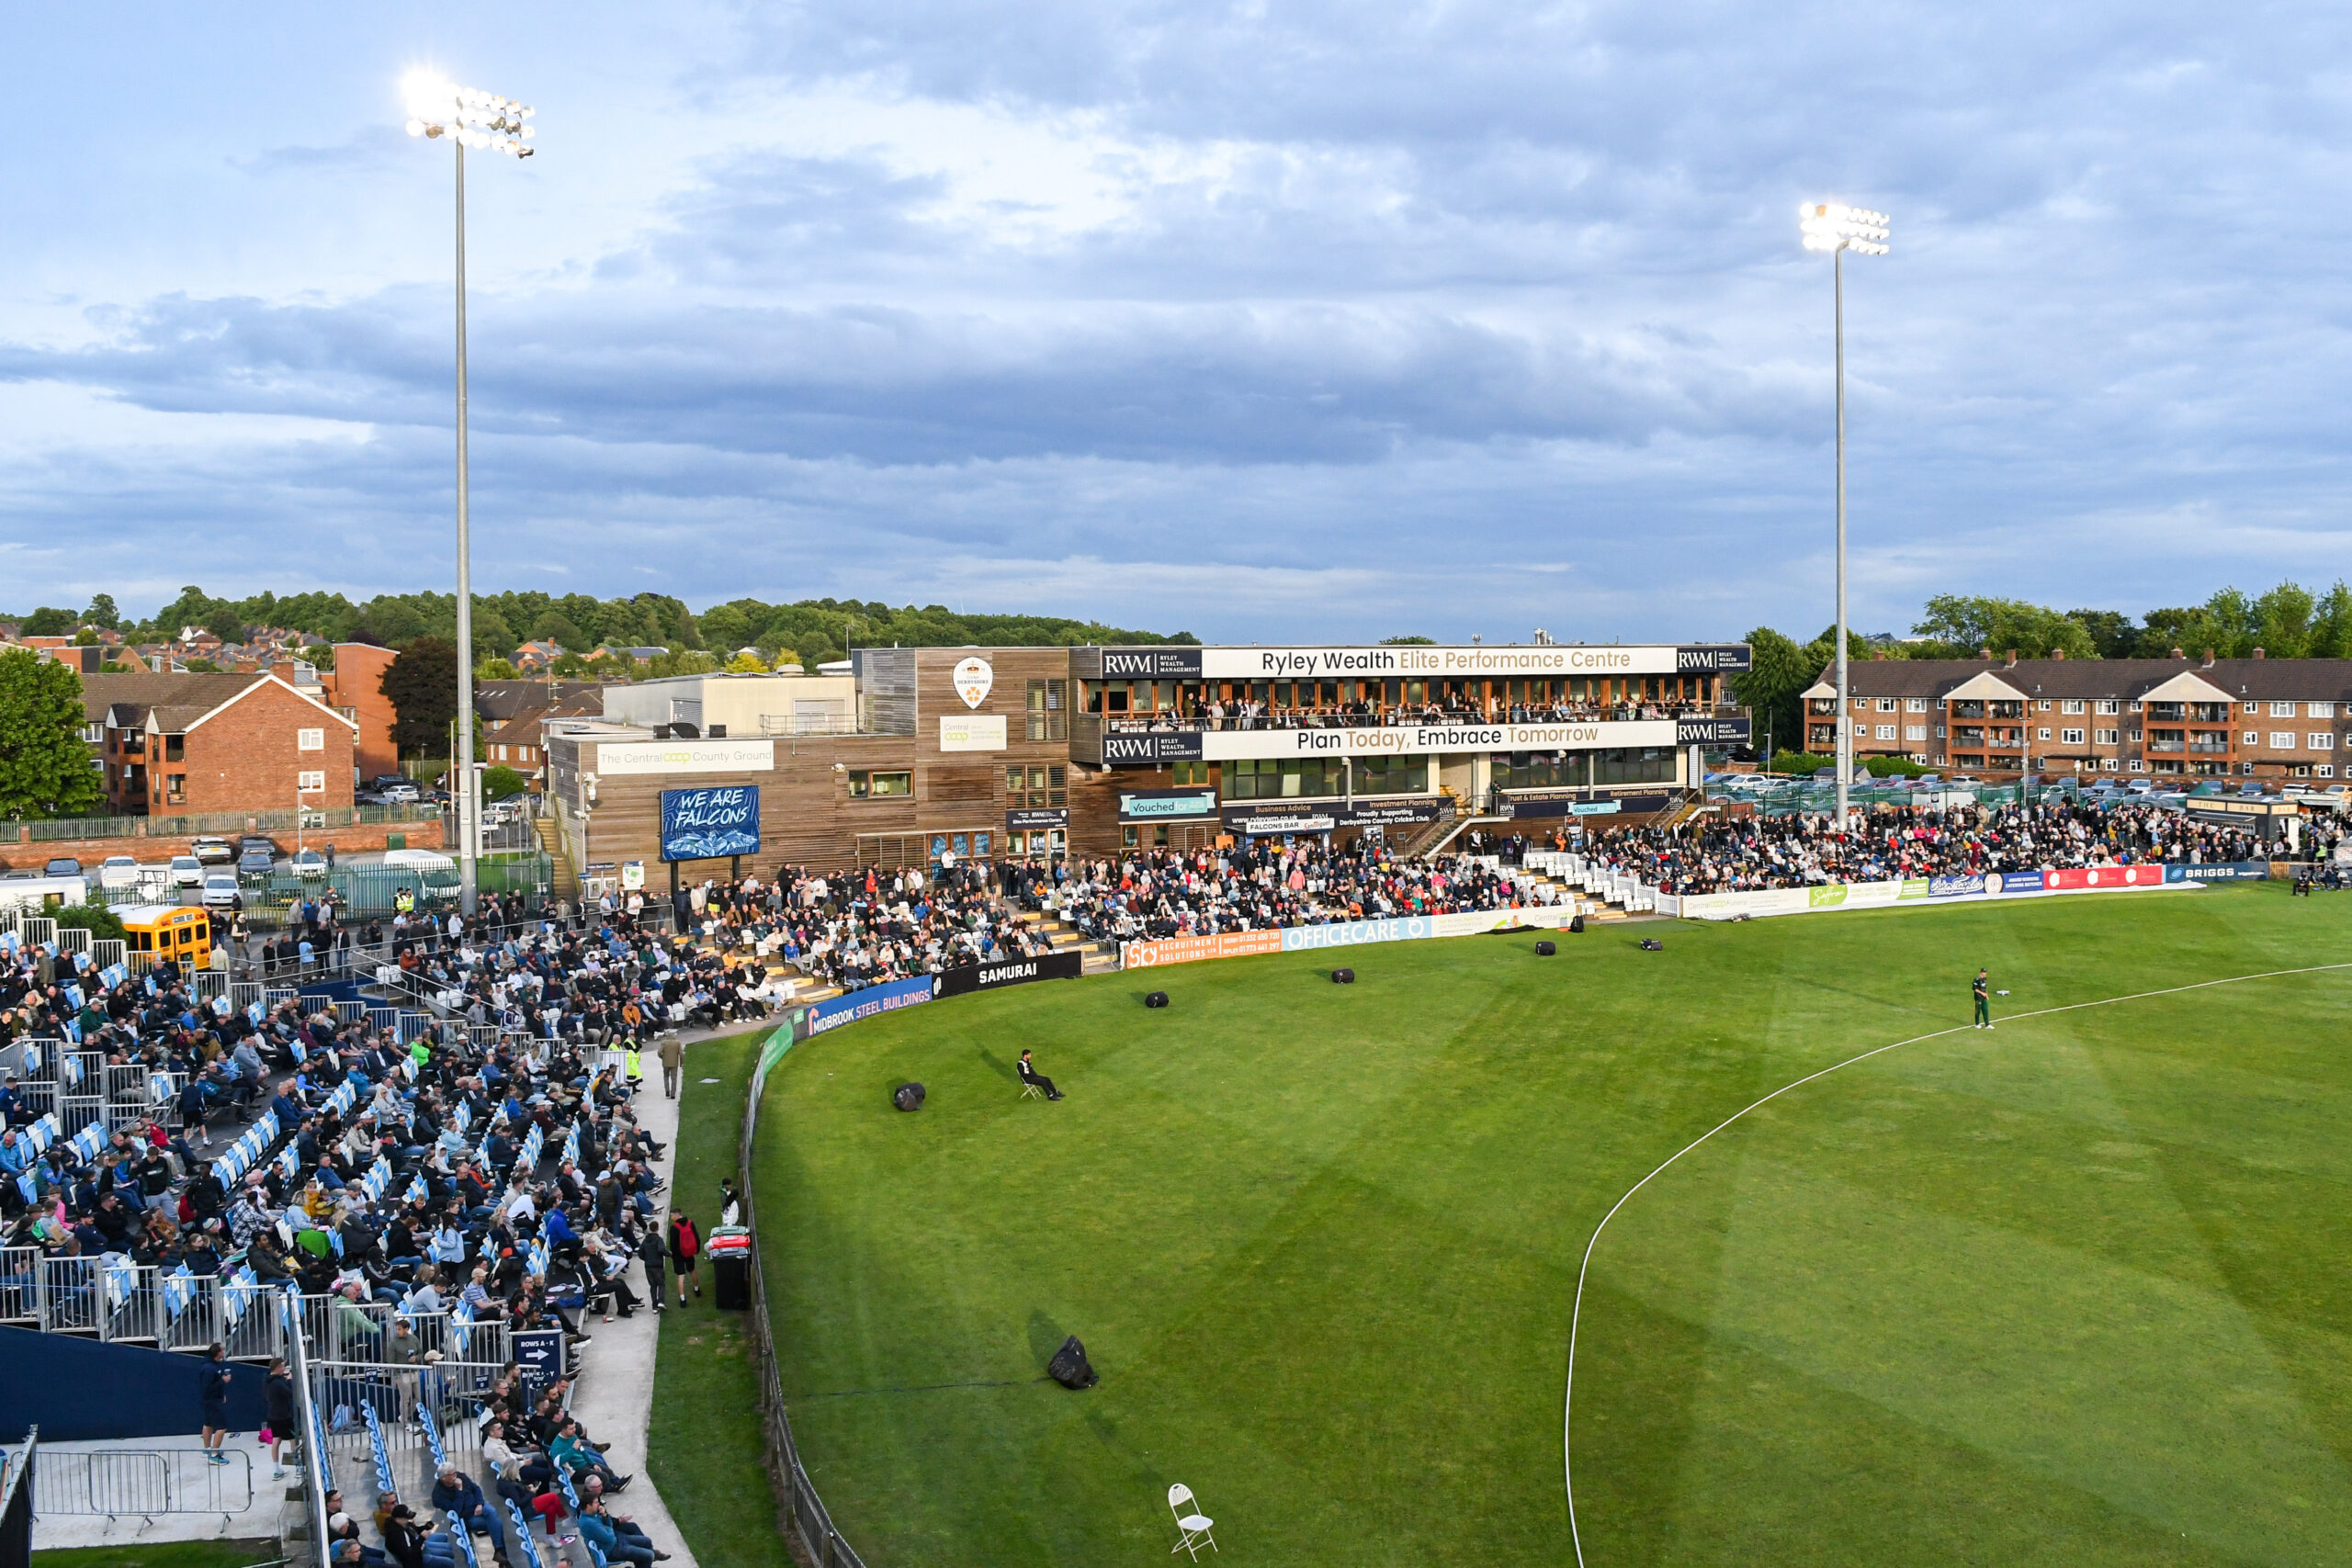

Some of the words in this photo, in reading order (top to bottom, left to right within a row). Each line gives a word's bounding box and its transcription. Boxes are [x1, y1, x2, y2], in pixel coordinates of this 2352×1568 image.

[1104, 655, 1152, 673] RWM
[1261, 651, 1317, 676] Ryley
[1323, 650, 1395, 670] Wealth
[1399, 649, 1440, 670] Elite
[1445, 651, 1564, 669] Performance
[1571, 650, 1631, 668] Centre
[1678, 652, 1713, 668] RWM
[1297, 731, 1341, 750] Plan
[1346, 730, 1410, 752] Today,
[1418, 728, 1502, 746] Embrace
[1508, 727, 1599, 743] Tomorrow
[1678, 725, 1713, 740] RWM
[601, 754, 620, 763] The
[624, 751, 662, 763] Central
[662, 752, 691, 763] coop
[693, 750, 729, 762] County
[734, 750, 772, 761] Ground
[1104, 739, 1153, 758] RWM
[680, 792, 707, 809] WE
[709, 789, 744, 807] ARE
[1530, 793, 1549, 801] Estate
[1550, 792, 1577, 800] Planning
[1610, 789, 1642, 797] Retirement
[1644, 788, 1668, 796] Planning
[1370, 799, 1408, 807] Investment
[674, 807, 749, 829] FALCONS
[1340, 818, 1371, 826] Derbyshire
[2186, 868, 2234, 877] BRIGGS
[1288, 921, 1399, 948] OFFICECARE
[1159, 938, 1216, 950] RECRUITMENT
[1160, 950, 1205, 962] SOLUTIONS
[979, 963, 1036, 984] SAMURAI
[813, 1010, 854, 1034] MIDBROOK
[856, 1003, 881, 1019] STEEL
[883, 989, 930, 1010] BUILDINGS
